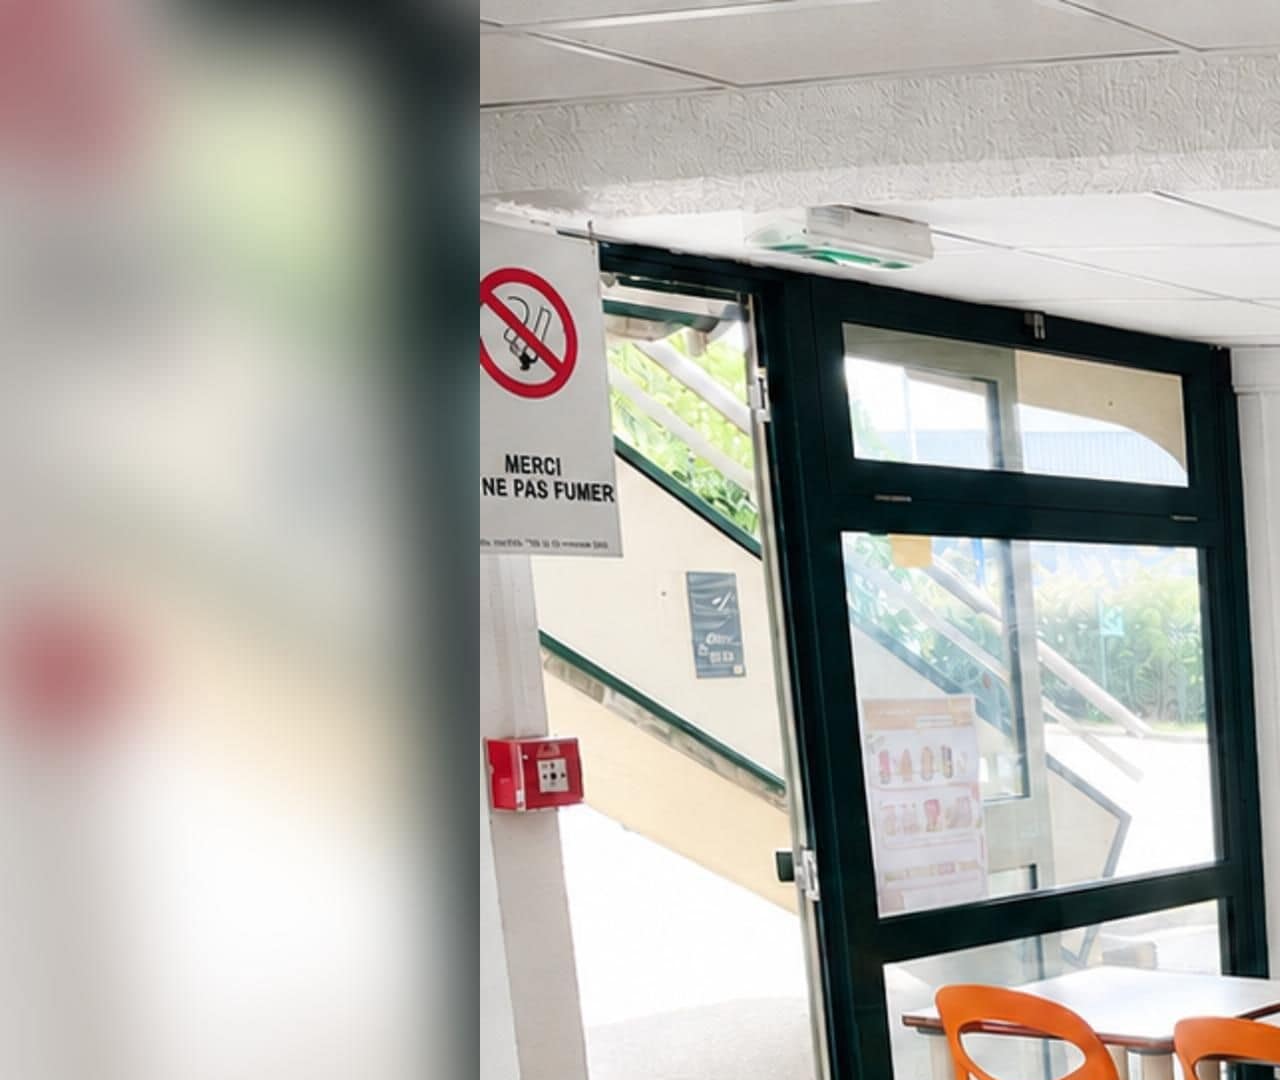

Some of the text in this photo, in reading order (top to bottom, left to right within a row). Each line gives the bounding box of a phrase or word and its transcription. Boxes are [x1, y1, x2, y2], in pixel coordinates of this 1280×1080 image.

[505, 453, 562, 477] MERCI
[482, 477, 615, 503] NE PAS FUMER
